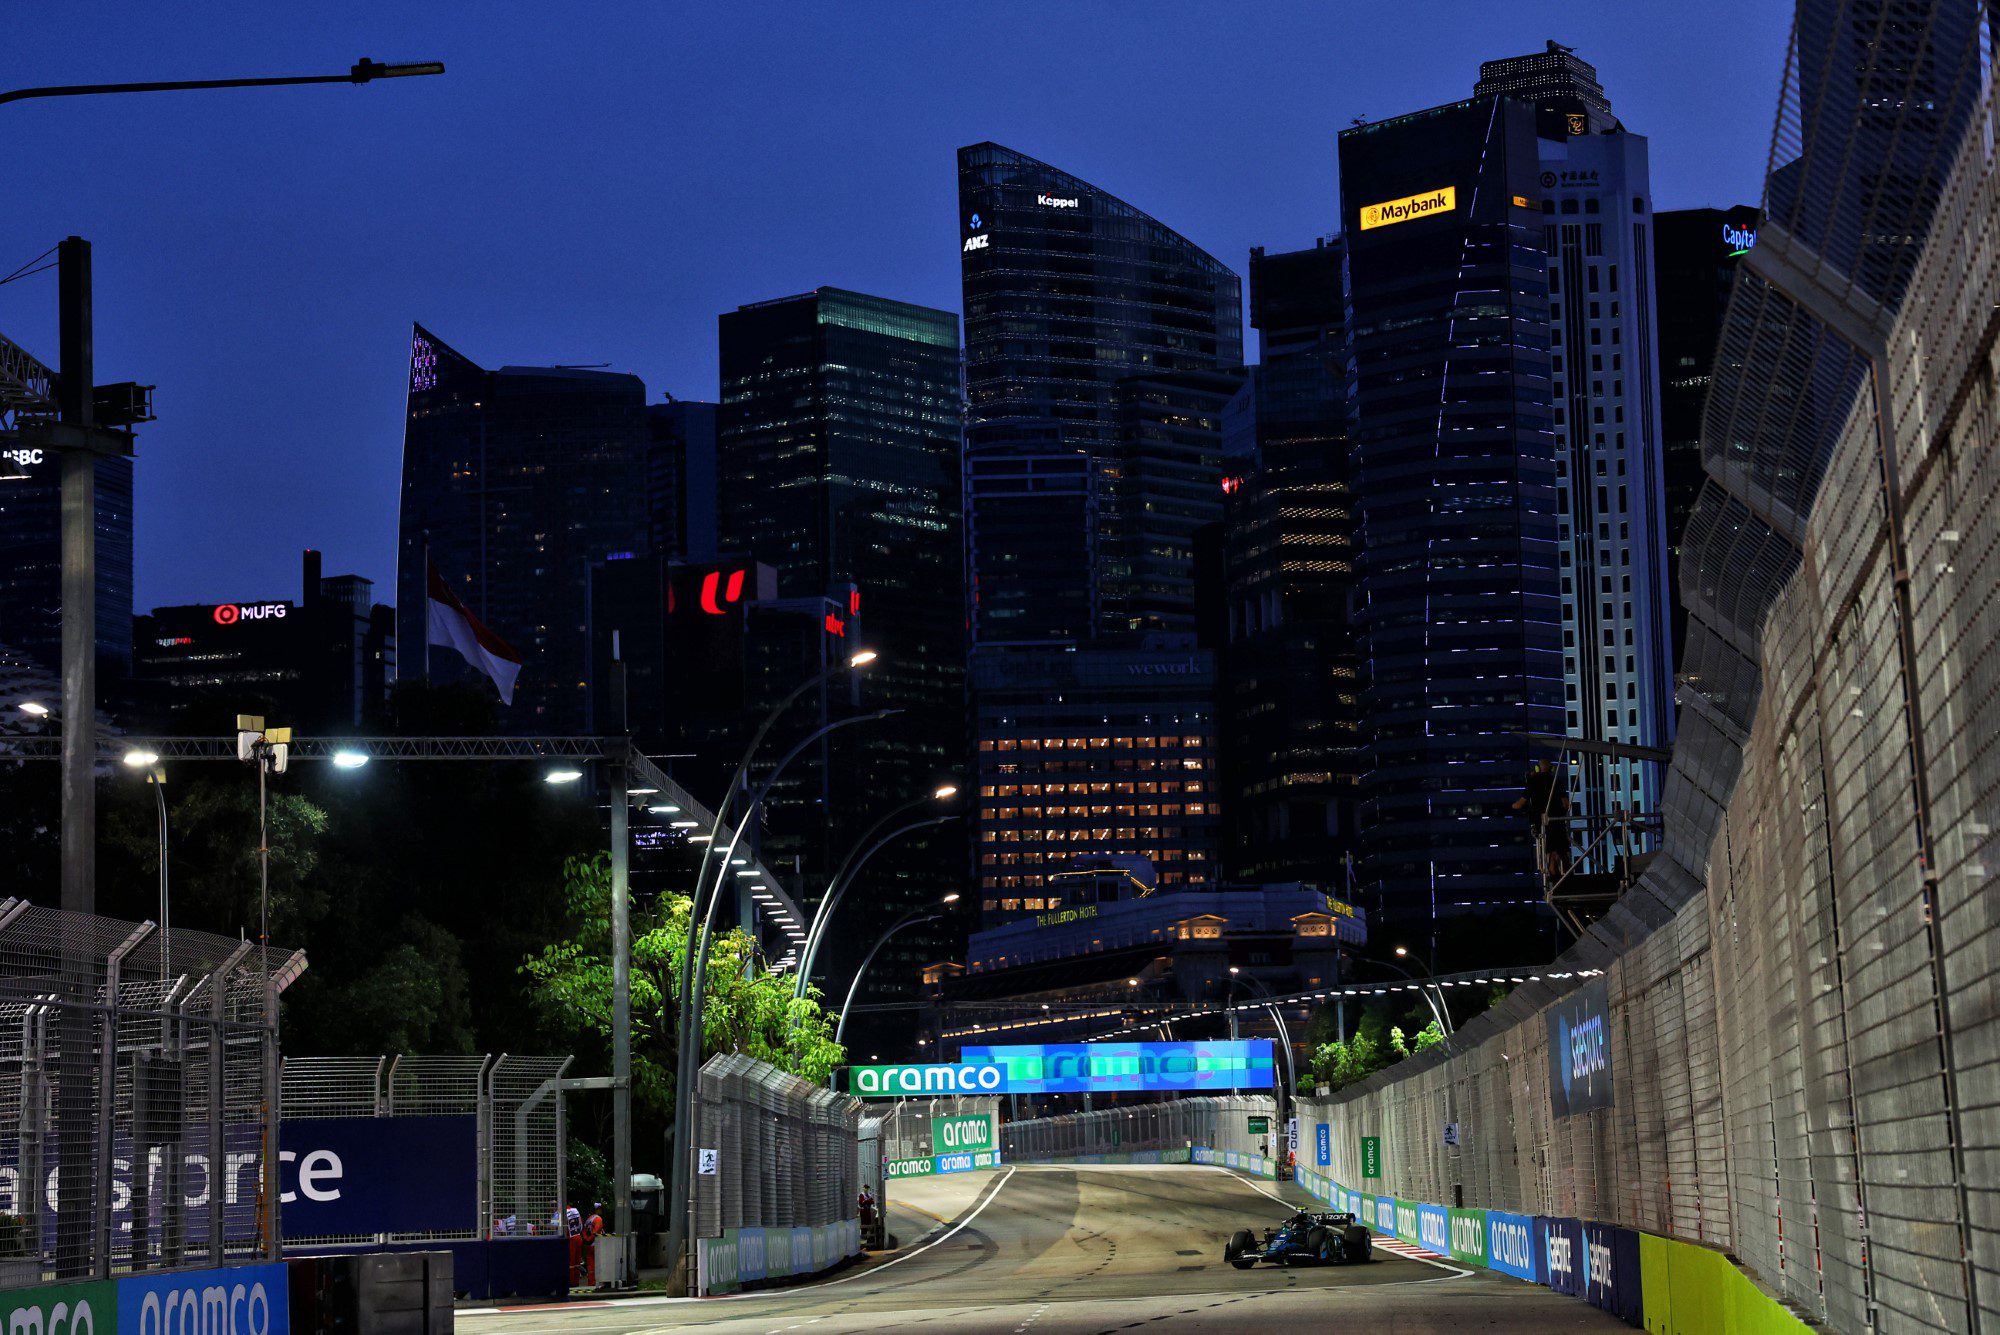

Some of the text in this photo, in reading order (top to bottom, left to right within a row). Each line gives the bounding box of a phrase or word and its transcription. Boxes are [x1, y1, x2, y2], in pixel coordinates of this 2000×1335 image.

[1037, 194, 1079, 209] Keppel
[1381, 193, 1447, 221] Maybank
[963, 234, 990, 252] ANZ
[241, 604, 287, 620] MUFG
[1127, 656, 1200, 676] wework
[1036, 905, 1098, 927] THE FULLERTON HOTEL
[1570, 998, 1605, 1097] salesforce
[856, 1065, 1001, 1093] aramco
[943, 1119, 988, 1147] aramco
[1290, 1120, 1298, 1150] 150
[888, 1159, 931, 1176] aramco
[1162, 1150, 1188, 1161] aramco
[1396, 1206, 1417, 1239] aramco
[1421, 1210, 1445, 1248] aramco
[1451, 1215, 1483, 1257] aramco
[1491, 1220, 1529, 1270] aramco
[0, 1299, 94, 1335] mco
[140, 1281, 269, 1335] aramco
